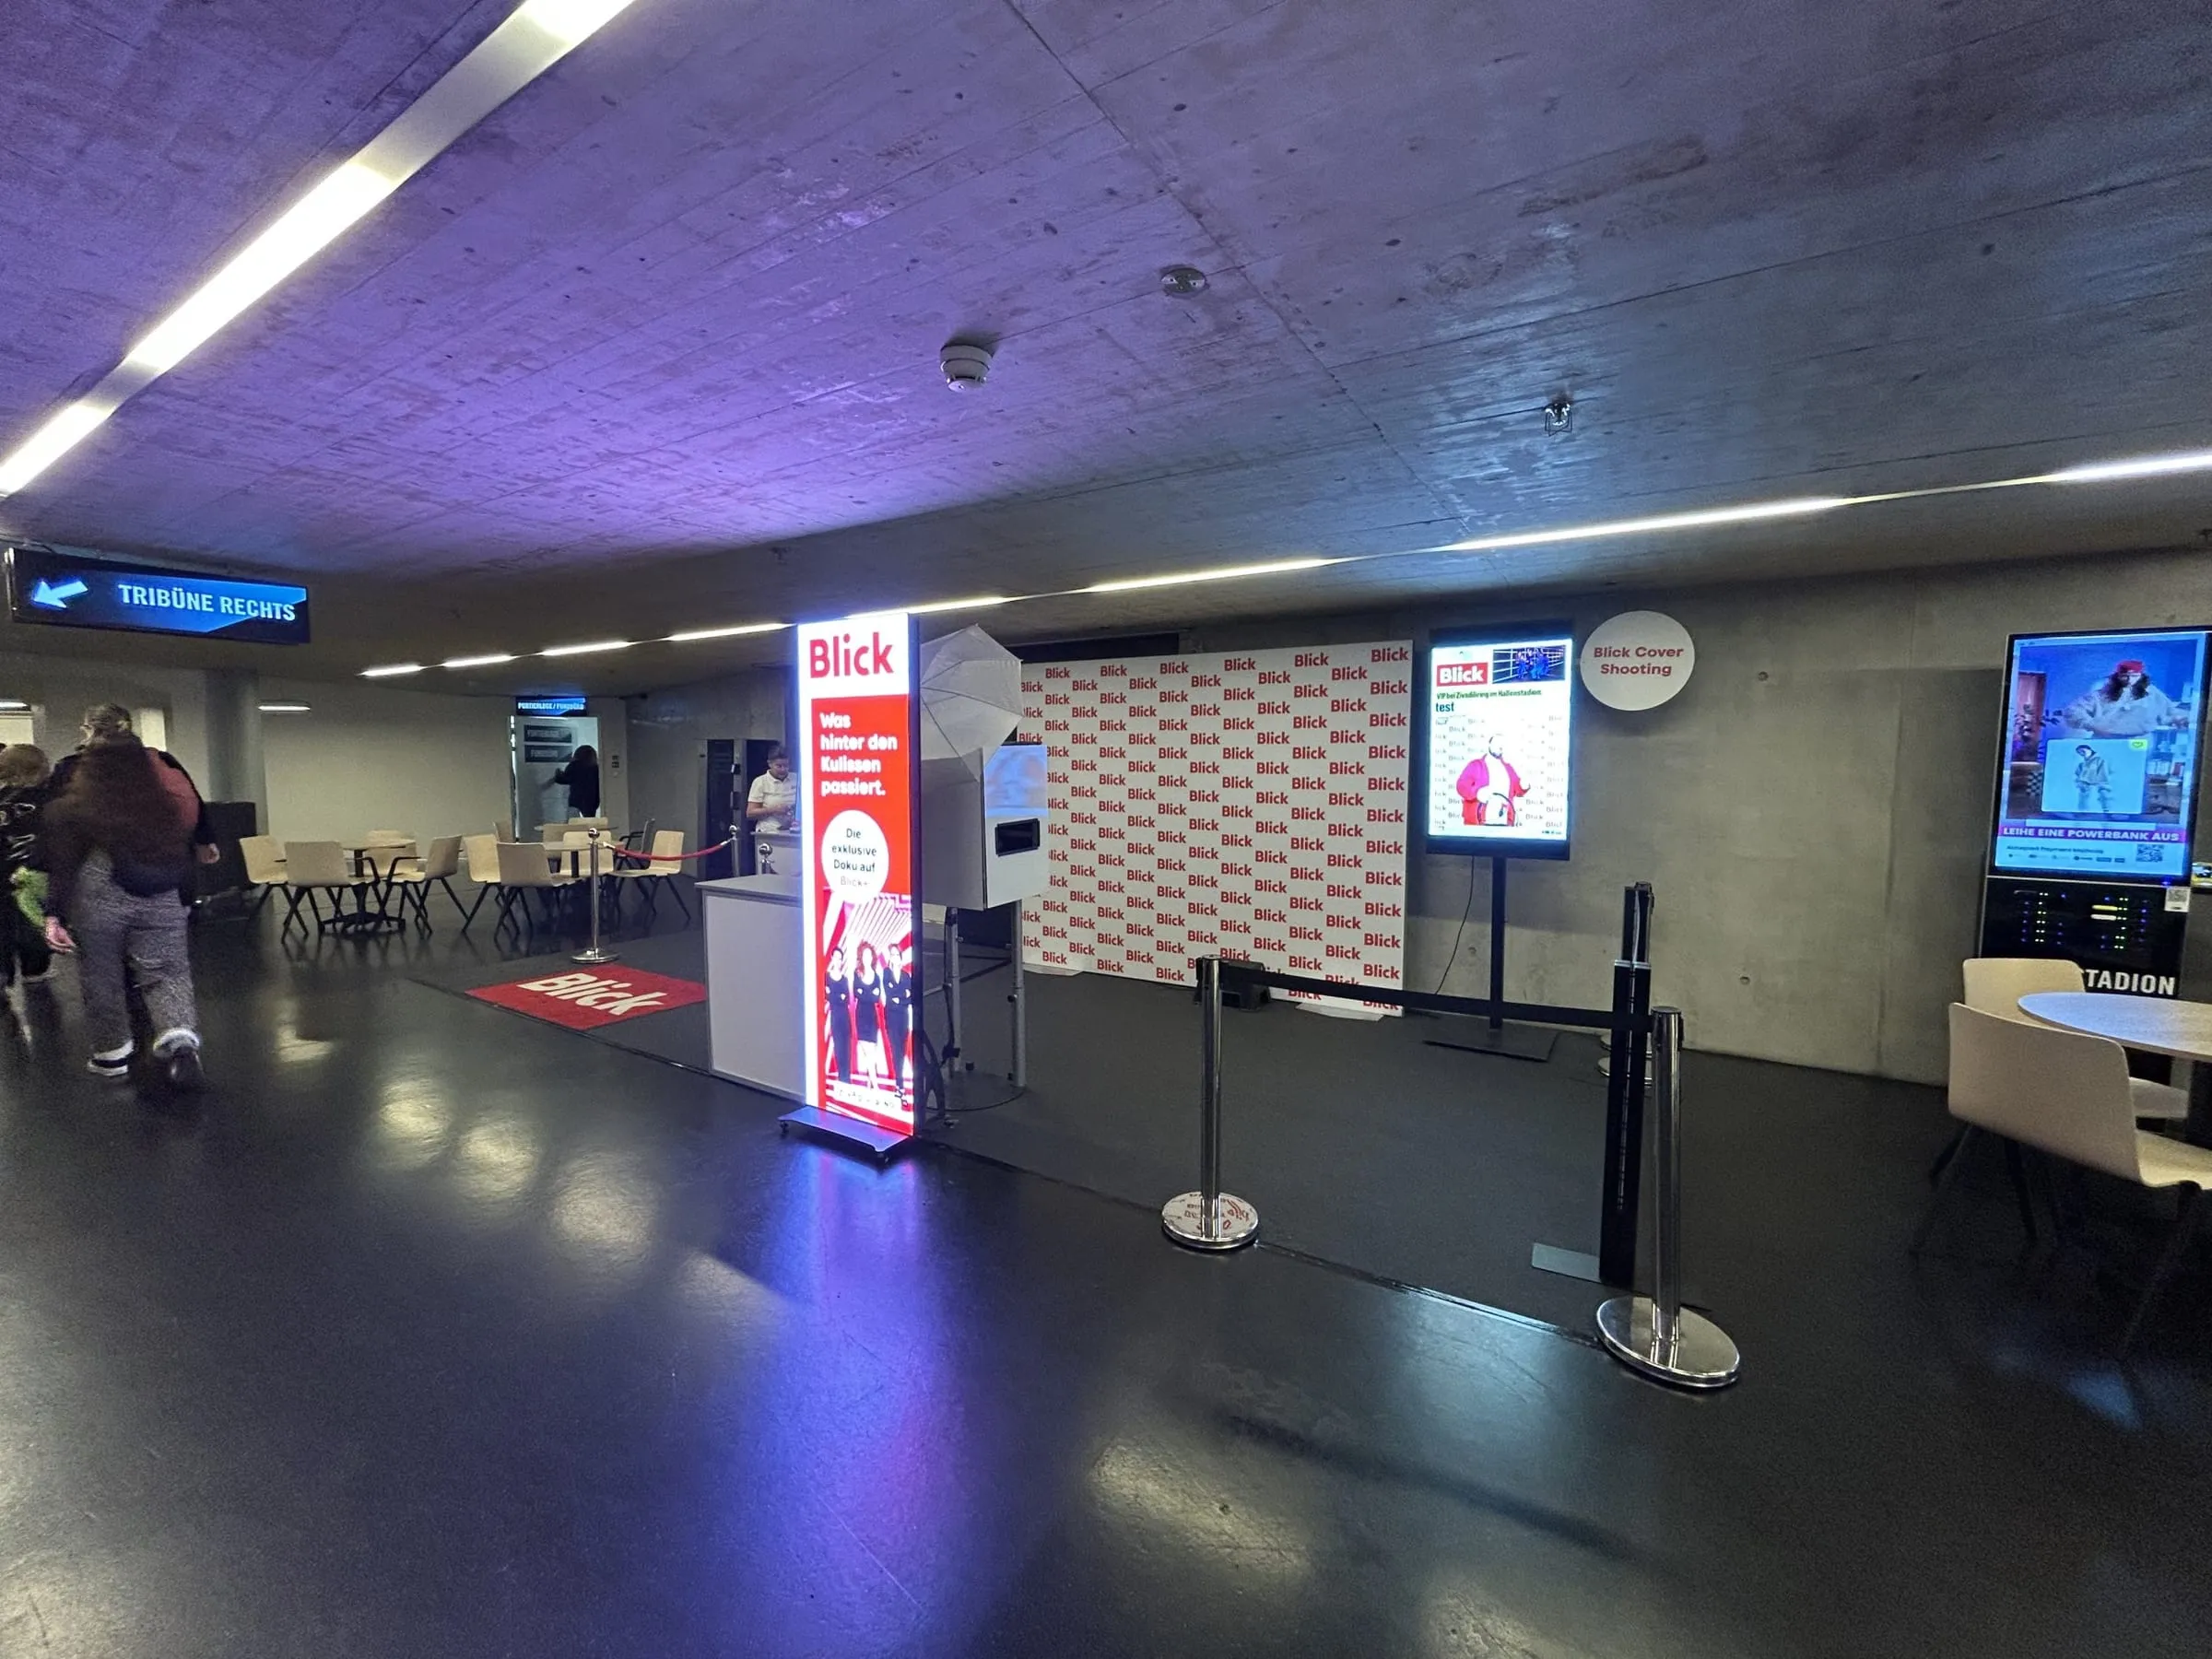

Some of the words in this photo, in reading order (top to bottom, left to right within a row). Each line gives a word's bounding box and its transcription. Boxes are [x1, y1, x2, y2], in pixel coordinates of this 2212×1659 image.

[119, 583, 214, 612] TRIBÜNE
[220, 595, 296, 621] RECHTS
[809, 631, 894, 678] Blick
[1371, 648, 1408, 662] Blick
[1594, 647, 1630, 657] Blick
[1635, 647, 1684, 657] Cover
[1224, 658, 1256, 671] Blick
[1295, 653, 1329, 667] Blick
[1046, 667, 1070, 678] Blick
[1100, 665, 1127, 677] Blick
[1160, 662, 1189, 675] Blick
[1332, 665, 1368, 681] Blick
[1440, 665, 1484, 684] Blick
[1600, 663, 1672, 677] Shooting
[1129, 677, 1158, 689] Blick
[1191, 675, 1221, 688] Blick
[1258, 671, 1290, 685] Blick
[1021, 681, 1043, 692] Blick
[1072, 679, 1098, 691] Blick
[1294, 684, 1328, 698] Blick
[1371, 680, 1407, 695] Blick
[1045, 693, 1070, 705] Blick
[1100, 692, 1126, 704] Blick
[1159, 690, 1188, 702] Blick
[1224, 688, 1254, 700] Blick
[1129, 705, 1157, 717] Blick
[1191, 703, 1220, 716] Blick
[1258, 701, 1290, 714] Blick
[1331, 698, 1367, 712] Blick
[1436, 701, 1454, 712] test
[1072, 706, 1097, 718] Blick
[819, 712, 852, 729] Was
[1045, 720, 1069, 731] Blick
[1100, 719, 1126, 731] Blick
[1159, 719, 1187, 731] Blick
[1223, 717, 1254, 730] Blick
[1293, 715, 1327, 729] Blick
[1370, 712, 1406, 727] Blick
[819, 735, 865, 750] hinter
[867, 734, 898, 750] den
[1019, 733, 1042, 744] Blick
[1072, 733, 1097, 745] Blick
[1129, 733, 1156, 745] Blick
[1191, 733, 1220, 745] Blick
[1257, 731, 1289, 745] Blick
[1330, 730, 1366, 744] Blick
[1100, 747, 1126, 759] Blick
[1159, 747, 1187, 759] Blick
[1223, 747, 1253, 759] Blick
[1292, 746, 1326, 759] Blick
[1369, 745, 1406, 759] Blick
[819, 756, 881, 773] Kulissen
[1071, 759, 1097, 771] Blick
[1128, 760, 1156, 772] Blick
[1190, 761, 1219, 774] Blick
[1257, 761, 1289, 774] Blick
[1329, 761, 1365, 774] Blick
[1100, 773, 1125, 785] Blick
[1158, 775, 1187, 787] Blick
[1222, 776, 1253, 789] Blick
[1292, 776, 1325, 790] Blick
[1368, 777, 1405, 791] Blick
[820, 777, 886, 797] passiert.
[1071, 786, 1097, 798] Blick
[1128, 788, 1156, 800] Blick
[1190, 790, 1219, 803] Blick
[1256, 791, 1288, 805] Blick
[1328, 793, 1364, 806] Blick
[1099, 800, 1125, 813] Blick
[1158, 803, 1186, 816] Blick
[1222, 805, 1253, 818] Blick
[1071, 812, 1097, 825] Blick
[1291, 807, 1325, 820] Blick
[1367, 808, 1404, 822] Blick
[1128, 815, 1155, 828] Blick
[1189, 818, 1219, 831] Blick
[1255, 821, 1288, 834] Blick
[846, 828, 861, 839] Die
[1099, 827, 1125, 840] Blick
[1158, 830, 1186, 843] Blick
[1328, 823, 1363, 837] Blick
[2003, 828, 2034, 836] LEIHE
[2038, 829, 2064, 837] EINE
[2067, 830, 2149, 840] POWERBANK
[2151, 832, 2180, 841] AUS
[1071, 839, 1096, 851] Blick
[1221, 834, 1253, 847] Blick
[1290, 837, 1324, 851] Blick
[831, 844, 877, 856] exklusive
[1127, 842, 1155, 855] Blick
[1189, 846, 1219, 859] Blick
[1366, 841, 1403, 854] Blick
[1099, 853, 1124, 866] Blick
[1255, 850, 1288, 864] Blick
[1327, 854, 1362, 868] Blick
[834, 859, 857, 871] Doku
[860, 862, 876, 873] auf
[1070, 865, 1096, 877] Blick
[1158, 858, 1186, 871] Blick
[1221, 863, 1253, 877] Blick
[1127, 870, 1155, 883] Blick
[1290, 867, 1324, 881] Blick
[1366, 871, 1402, 886] Blick
[1098, 880, 1124, 893] Blick
[1188, 875, 1218, 888] Blick
[1254, 879, 1287, 893] Blick
[1070, 890, 1096, 903] Blick
[1158, 886, 1185, 900] Blick
[1220, 891, 1252, 905] Blick
[1327, 885, 1361, 899] Blick
[1043, 900, 1067, 913] Blick
[1127, 896, 1154, 910] Blick
[1188, 902, 1218, 916] Blick
[1289, 897, 1324, 912] Blick
[1365, 902, 1401, 917] Blick
[1098, 907, 1124, 920] Blick
[1157, 912, 1185, 927] Blick
[1254, 909, 1287, 923] Blick
[1069, 916, 1095, 929] Blick
[1220, 920, 1252, 934] Blick
[1326, 914, 1361, 929] Blick
[1042, 925, 1067, 939] Blick
[1126, 923, 1154, 936] Blick
[1289, 926, 1323, 941] Blick
[1098, 933, 1124, 947] Blick
[1188, 930, 1218, 945] Blick
[1364, 933, 1400, 948] Blick
[1069, 942, 1095, 956] Blick
[1157, 940, 1184, 954] Blick
[1253, 937, 1286, 952] Blick
[1042, 951, 1067, 964] Blick
[1126, 950, 1154, 964] Blick
[1219, 947, 1251, 962] Blick
[1325, 945, 1360, 959] Blick
[1097, 959, 1124, 972] Blick
[1288, 955, 1323, 971] Blick
[1157, 968, 1184, 982] Blick
[1363, 964, 1399, 980] Blick
[2084, 969, 2175, 995] TADION
[516, 972, 668, 1016] Blick
